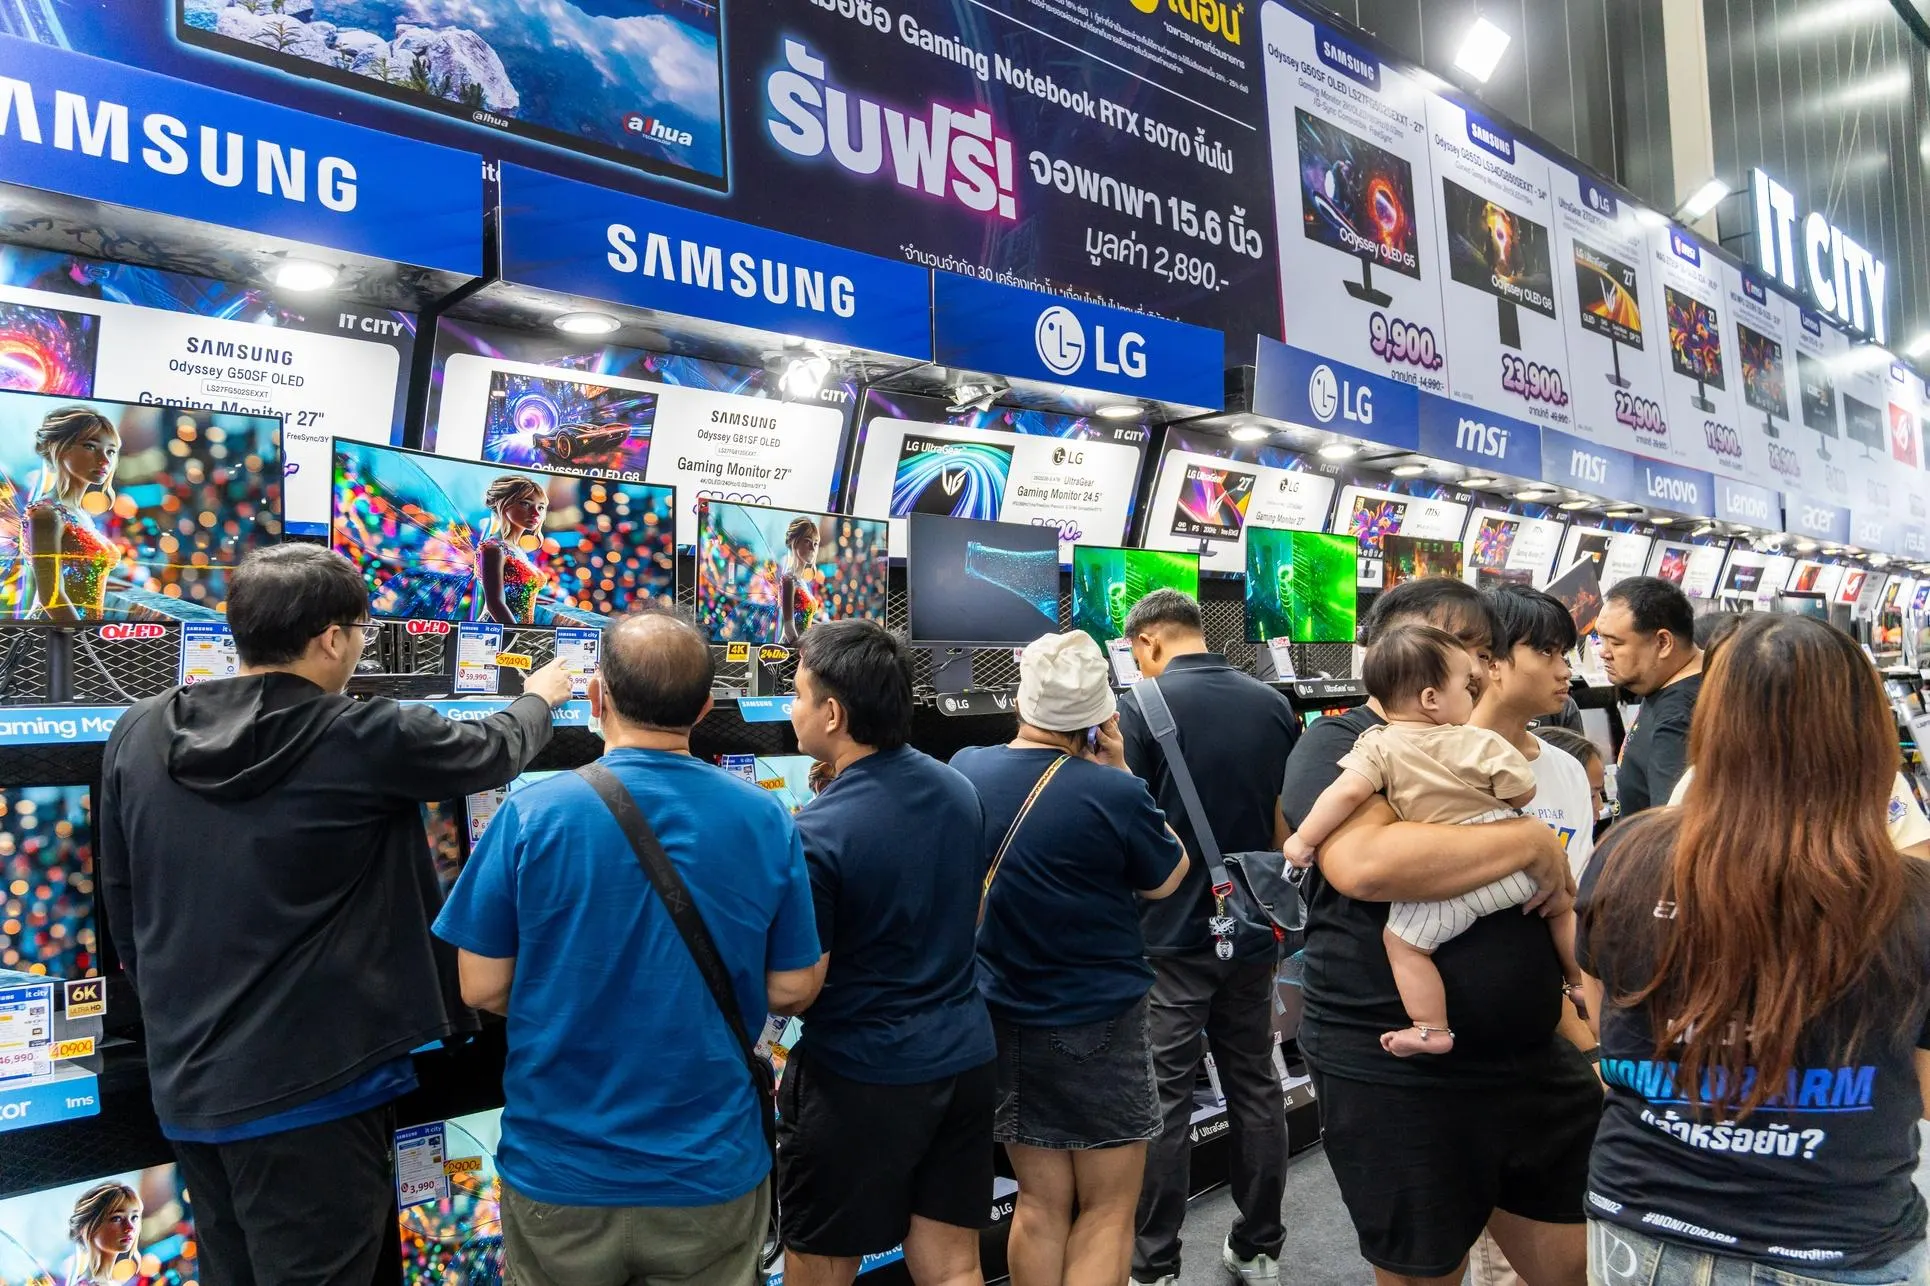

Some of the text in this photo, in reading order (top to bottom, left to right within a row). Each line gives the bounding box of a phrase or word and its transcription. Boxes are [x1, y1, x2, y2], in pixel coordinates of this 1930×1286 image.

[1267, 42, 1300, 73] Odyssey
[1300, 61, 1326, 84] G50SF
[1327, 74, 1348, 95] OLED
[1323, 41, 1375, 81] SAMSUNG
[899, 14, 989, 81] Gaming
[994, 53, 1095, 116] Notebook
[1099, 98, 1141, 138] RTX
[1144, 120, 1191, 157] 5070
[1194, 126, 1234, 175] ขึ้นไป
[766, 38, 1018, 220] รับฟรี!
[1471, 122, 1511, 156] SAMSUNG
[1028, 149, 1264, 260] จอพกพา 15.6 นิ้ว
[1598, 195, 1610, 213] LG
[1339, 227, 1416, 269] Odyssey OLED G5
[1753, 167, 1887, 346] IT CITY
[1085, 226, 1230, 292] มูลค่า 2,890.-
[606, 223, 856, 318] SAMSUNG
[977, 264, 993, 282] 30
[1491, 274, 1524, 302] Odyssey
[1524, 291, 1543, 307] OLED
[338, 313, 404, 338] IT CITY
[1369, 311, 1443, 371] 9,900.-
[185, 336, 294, 367] SAMSUNG
[1095, 325, 1147, 378] LG
[168, 358, 305, 388] Odyssey G50SF OLED
[1501, 353, 1569, 407] 23,900.-
[206, 383, 269, 399] LS27FG502SEXXT
[820, 388, 849, 404] CITY
[1343, 380, 1373, 425] LG
[296, 410, 325, 427] 27"
[711, 410, 778, 430] SAMSUNG
[286, 431, 330, 444] FreeSync/3Y
[697, 429, 781, 449] Odyssey G81SF OLED
[1113, 428, 1146, 442] IT CITY
[905, 440, 920, 451] LG
[1068, 451, 1085, 465] LG
[622, 471, 640, 482] G8
[677, 456, 793, 481] Gaming Monitor 27"
[1186, 468, 1197, 480] LG
[1319, 463, 1341, 474] IT CITY
[1063, 476, 1096, 488] UltraGear
[1288, 481, 1300, 493] LG
[1645, 467, 1698, 505] Lenovo
[1016, 485, 1049, 500] Gaming
[1049, 488, 1083, 501] Monitor
[1725, 486, 1769, 521] Lenovo
[1255, 510, 1277, 525] Gaming
[1801, 504, 1837, 533] acer
[100, 623, 166, 640] OLED
[405, 619, 451, 636] OLED
[730, 644, 746, 654] 4K
[1304, 686, 1314, 694] LG
[741, 700, 773, 708] SAMSUNG
[956, 700, 970, 710] LG
[25, 989, 49, 999] it city
[71, 984, 98, 1002] 6K
[70, 1004, 101, 1016] ULTRA HD
[65, 1094, 95, 1109] 1ms
[1284, 1096, 1294, 1106] LG
[430, 1126, 442, 1134] city
[998, 1202, 1014, 1216] LG
[1641, 1211, 1739, 1244] #MONITORARM
